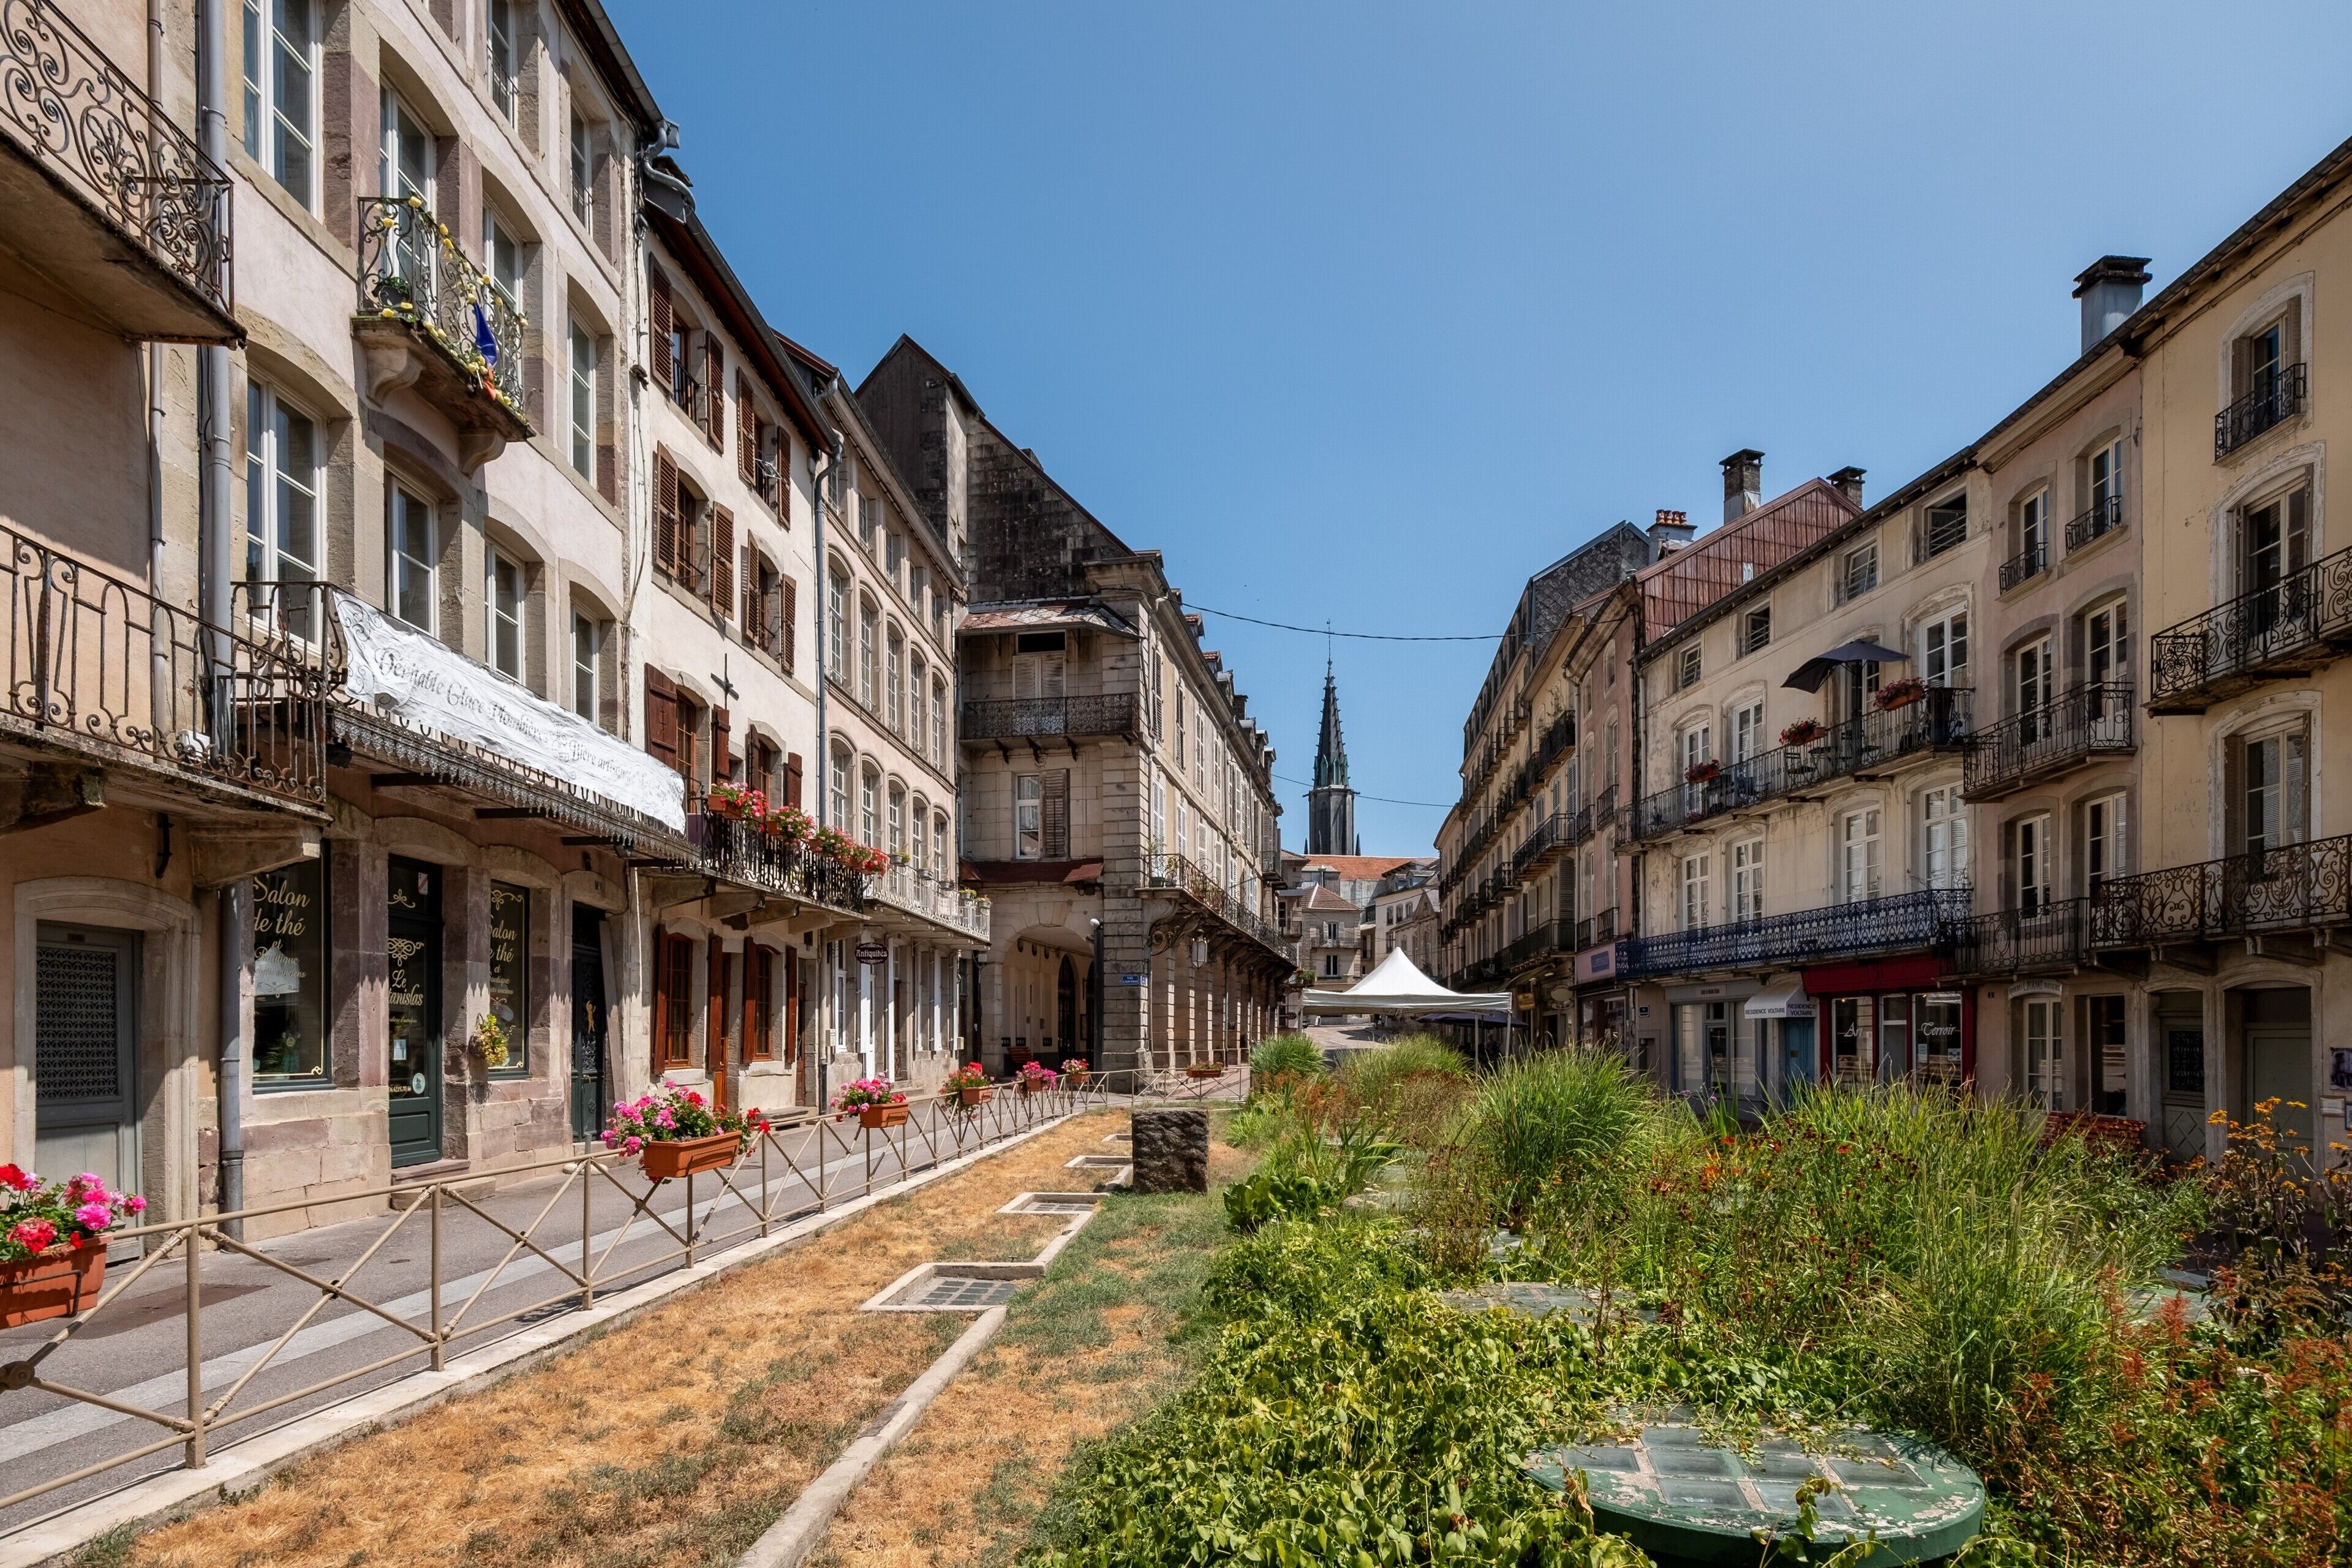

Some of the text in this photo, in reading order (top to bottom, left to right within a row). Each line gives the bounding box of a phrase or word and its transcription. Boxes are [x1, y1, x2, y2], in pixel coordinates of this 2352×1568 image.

[447, 681, 485, 714] Glace
[489, 700, 548, 743] Plombières
[569, 739, 597, 765] Bière
[253, 873, 311, 908] Salon
[275, 909, 306, 936] thé
[272, 938, 283, 950] et
[496, 942, 514, 963] thé
[856, 949, 888, 959] Antiquités
[392, 969, 407, 989] Le
[490, 971, 510, 985] outique
[494, 965, 501, 973] et
[388, 984, 423, 1006] tanislas
[1921, 1022, 1956, 1036] Terroir
